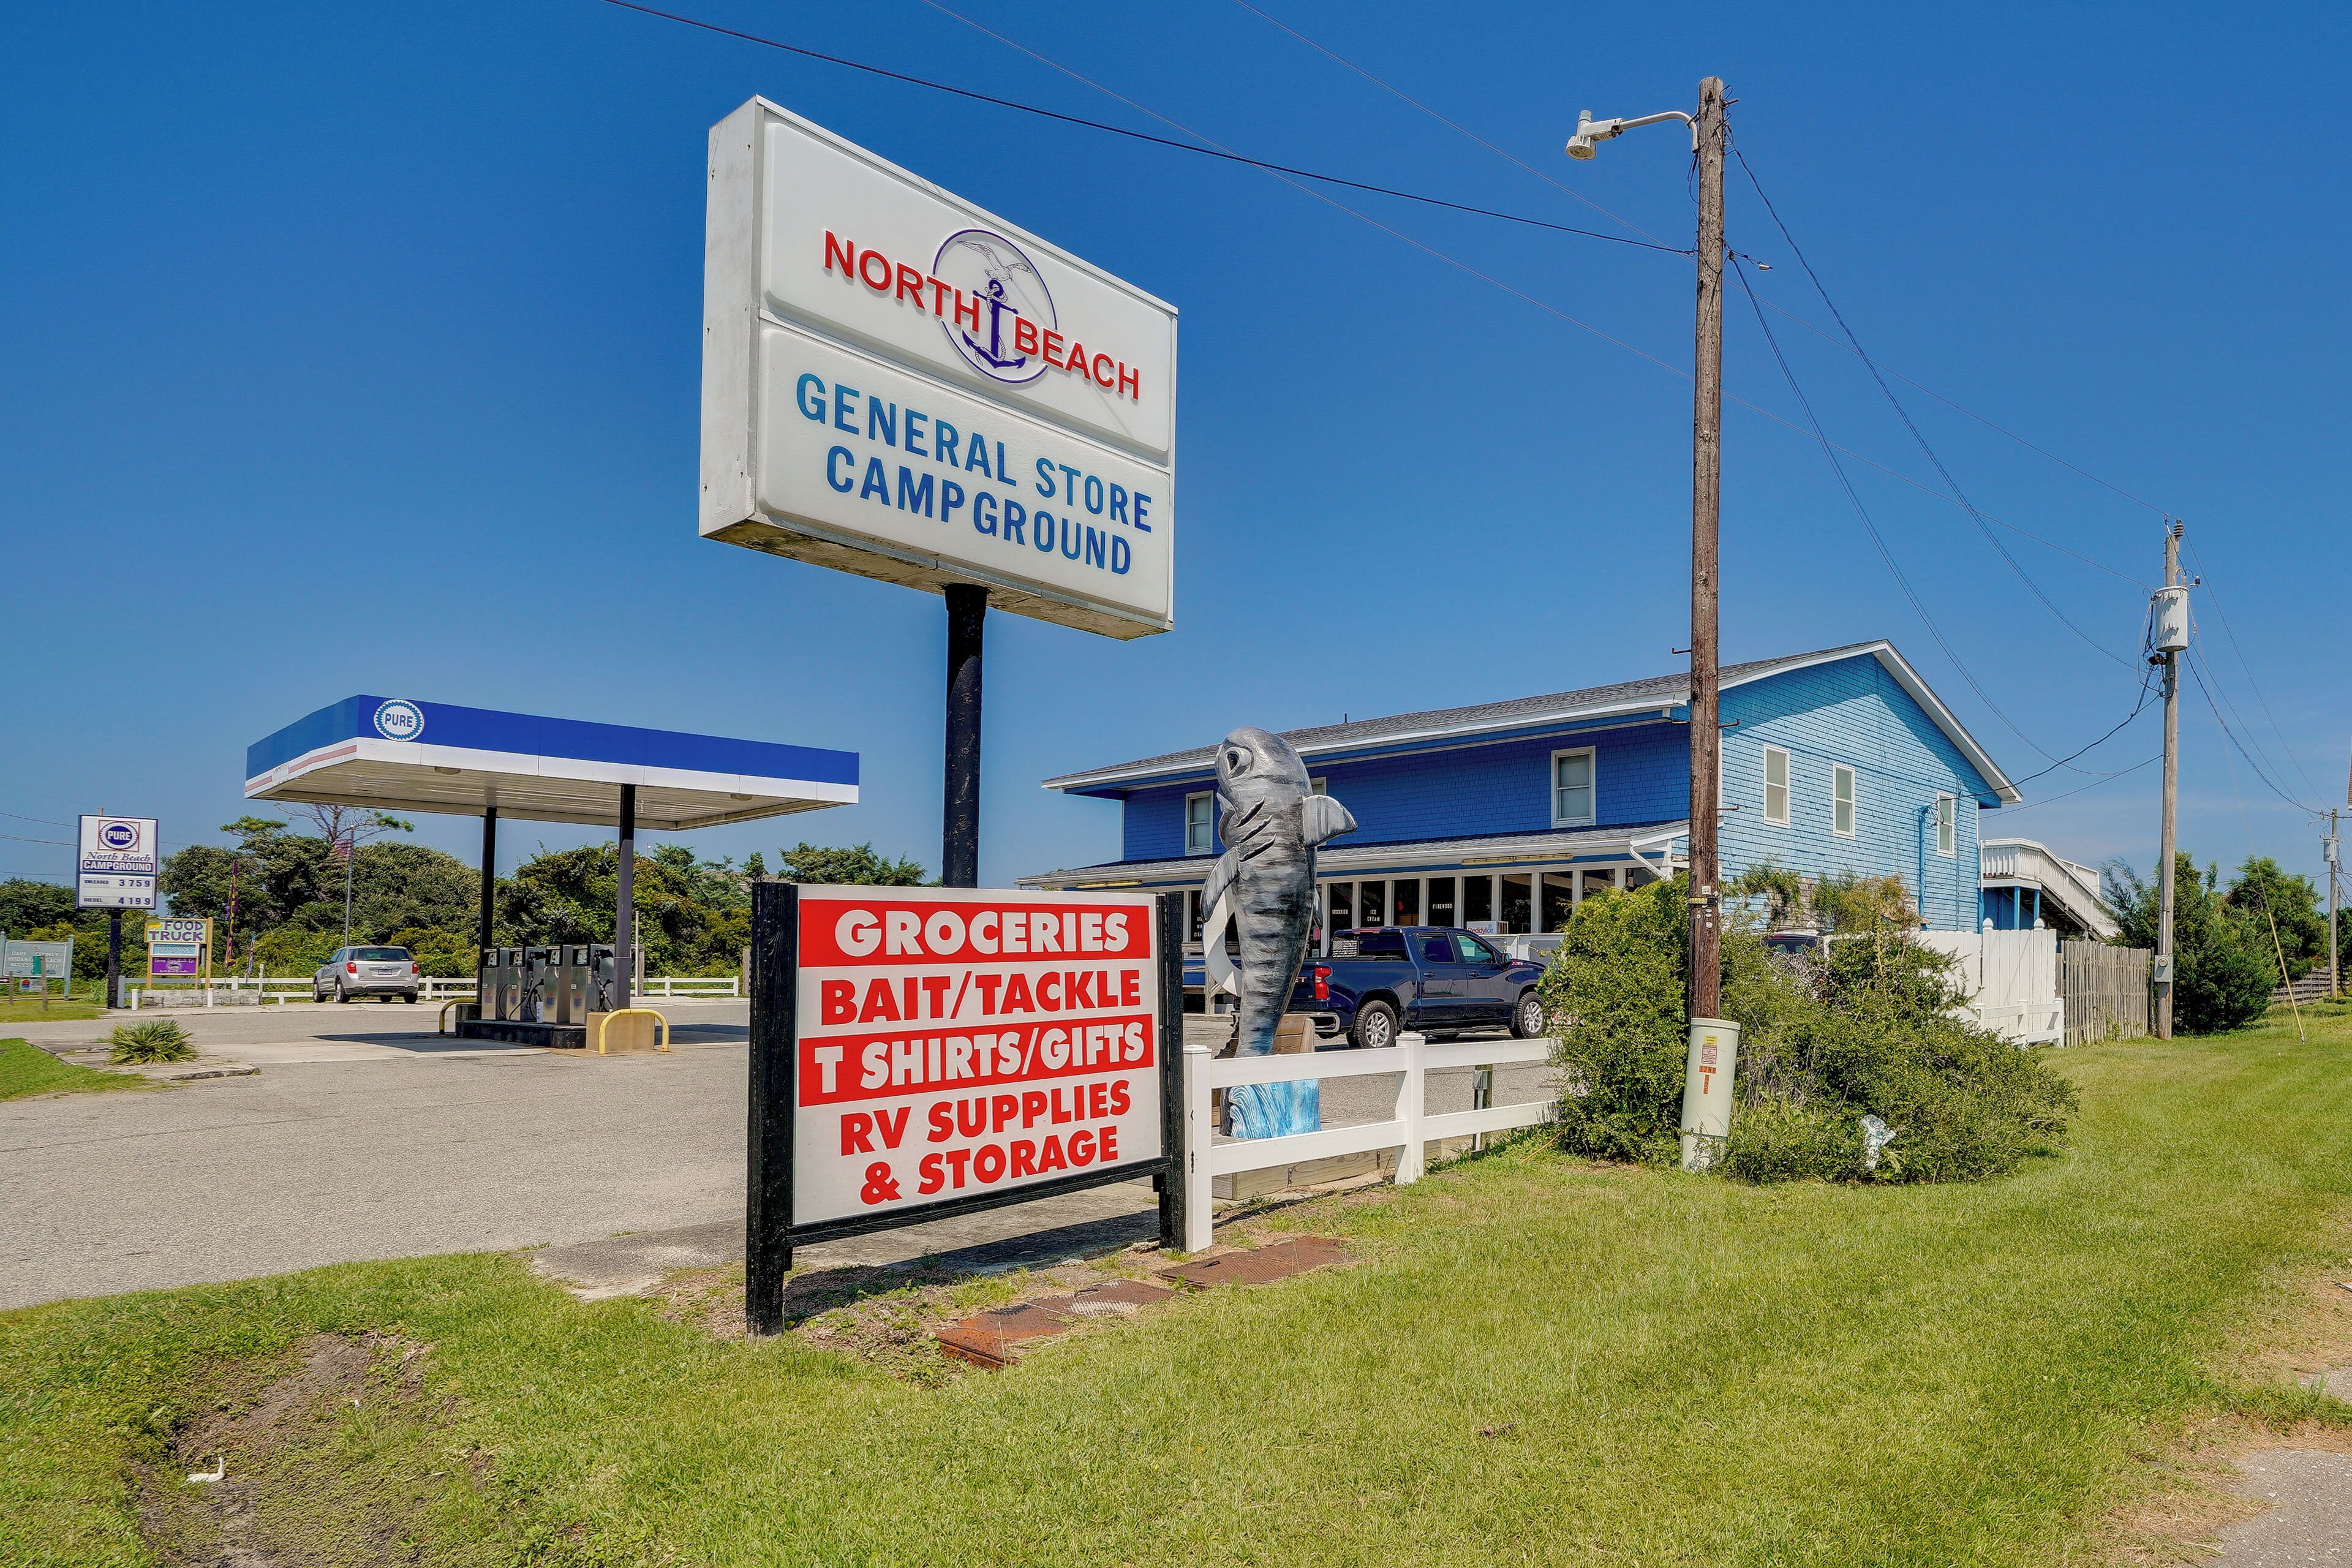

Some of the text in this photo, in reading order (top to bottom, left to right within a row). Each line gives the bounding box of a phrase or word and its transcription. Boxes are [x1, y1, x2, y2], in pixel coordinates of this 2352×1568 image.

[823, 229, 1139, 401] NORTH BEACH
[796, 373, 1152, 533] GENERAL STORE
[826, 445, 1131, 575] CAMPGROUND
[385, 713, 413, 728] PURE
[86, 851, 151, 862] North Beach
[107, 831, 130, 840] PURE
[83, 861, 151, 871] CAMPGROUND
[148, 931, 203, 941] TRUCK
[164, 921, 203, 931] FOOD
[835, 910, 1129, 957] GROCERIES
[821, 970, 1141, 1025] BAIT/TACKLE
[814, 1022, 1144, 1093] T SHIRTS/GIFTS
[841, 1079, 1130, 1156] RV SUPPLIES
[860, 1126, 1118, 1205] & STORAGE
